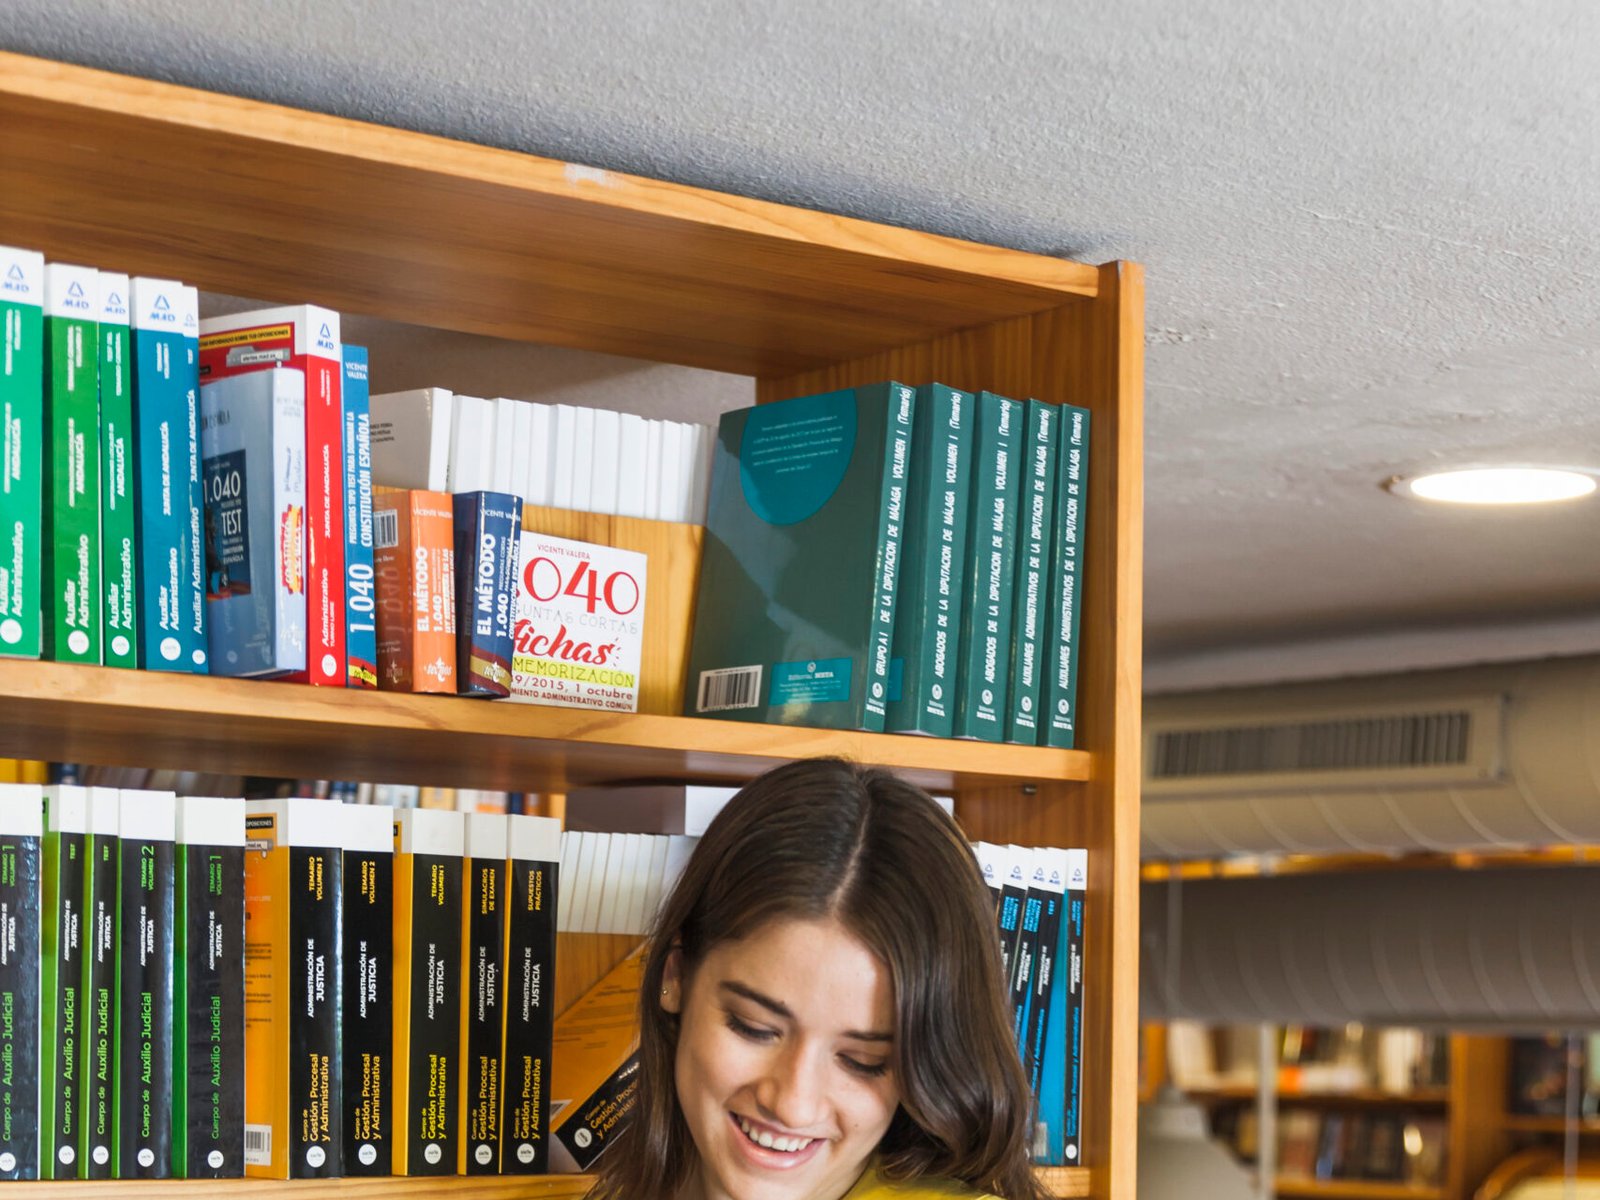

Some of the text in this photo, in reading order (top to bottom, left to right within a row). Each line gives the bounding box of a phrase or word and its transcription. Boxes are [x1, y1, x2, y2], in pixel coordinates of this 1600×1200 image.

[345, 362, 368, 372] VICENTE
[347, 370, 368, 380] VALERA
[898, 388, 912, 425] (Temario)
[950, 393, 962, 429] (Temario)
[74, 433, 85, 494] ANDALUCÍA
[114, 437, 124, 497] ANDALUCÍA
[160, 422, 171, 516] JUNTA DE ANDALUCÍA
[322, 444, 330, 496] ANDALUCÍA
[892, 440, 907, 479] VOLUMEN
[946, 444, 959, 483] VOLUMEN
[203, 471, 241, 504] 1.040
[356, 413, 372, 547] CONSTITUCIÓN ESPAÑOLA
[221, 509, 242, 536] TEST
[323, 497, 331, 511] DE
[888, 487, 901, 521] MÁLAGA
[942, 491, 955, 525] MÁLAGA
[888, 525, 898, 537] DE
[942, 529, 953, 542] DE
[1058, 412, 1083, 689] AUXILIARES ADMINISTRATIVOS DE LA DIPUTACION DE MÁLAGA (Temario)
[12, 521, 24, 617] Administrativo
[190, 507, 203, 634] Auxiliar Administrativo
[537, 543, 591, 560] VICENTE VALERA
[884, 541, 897, 591] DIPUTACION
[939, 546, 952, 595] DIPUTACION
[78, 534, 89, 628] Administrativo
[121, 537, 132, 630] Administrativo
[169, 548, 180, 631] Administrativo
[349, 563, 375, 633] 1.040
[413, 546, 430, 632] EL MÉTODO
[475, 534, 496, 635] EL MÉTODO
[64, 579, 76, 627] Auxiliar
[109, 582, 120, 629] Auxiliar
[159, 585, 170, 630] Auxiliar
[321, 568, 329, 647] Administrativo
[432, 594, 443, 632] 1.040
[496, 594, 509, 637] 1.040
[518, 604, 638, 635] UNTAS CORTAS
[881, 610, 890, 623] DE
[883, 596, 891, 606] LA
[937, 614, 948, 627] DE
[939, 599, 948, 610] LA
[514, 619, 615, 665] fichas
[875, 645, 887, 676] GRUPO
[935, 631, 947, 678] ABOGADOS
[512, 675, 633, 700] 9/2015, 1 octubre
[513, 657, 635, 688] MEMORIZACIÓN
[542, 692, 603, 707] ADMINISTRATIVO
[605, 700, 633, 710] COMÚN
[141, 845, 154, 856] 2
[141, 906, 146, 914] DE
[489, 900, 495, 911] DE
[308, 939, 314, 949] DE
[316, 956, 325, 1001] JUSTICIA
[63, 987, 74, 1134] Cuerpo de Auxilio Judicial
[141, 992, 152, 1138] Cuerpo de Auxilio Judicial
[309, 1054, 319, 1142] Gestión Procesal
[320, 1056, 329, 1132] Administrativa
[590, 1101, 617, 1129] Gestión
